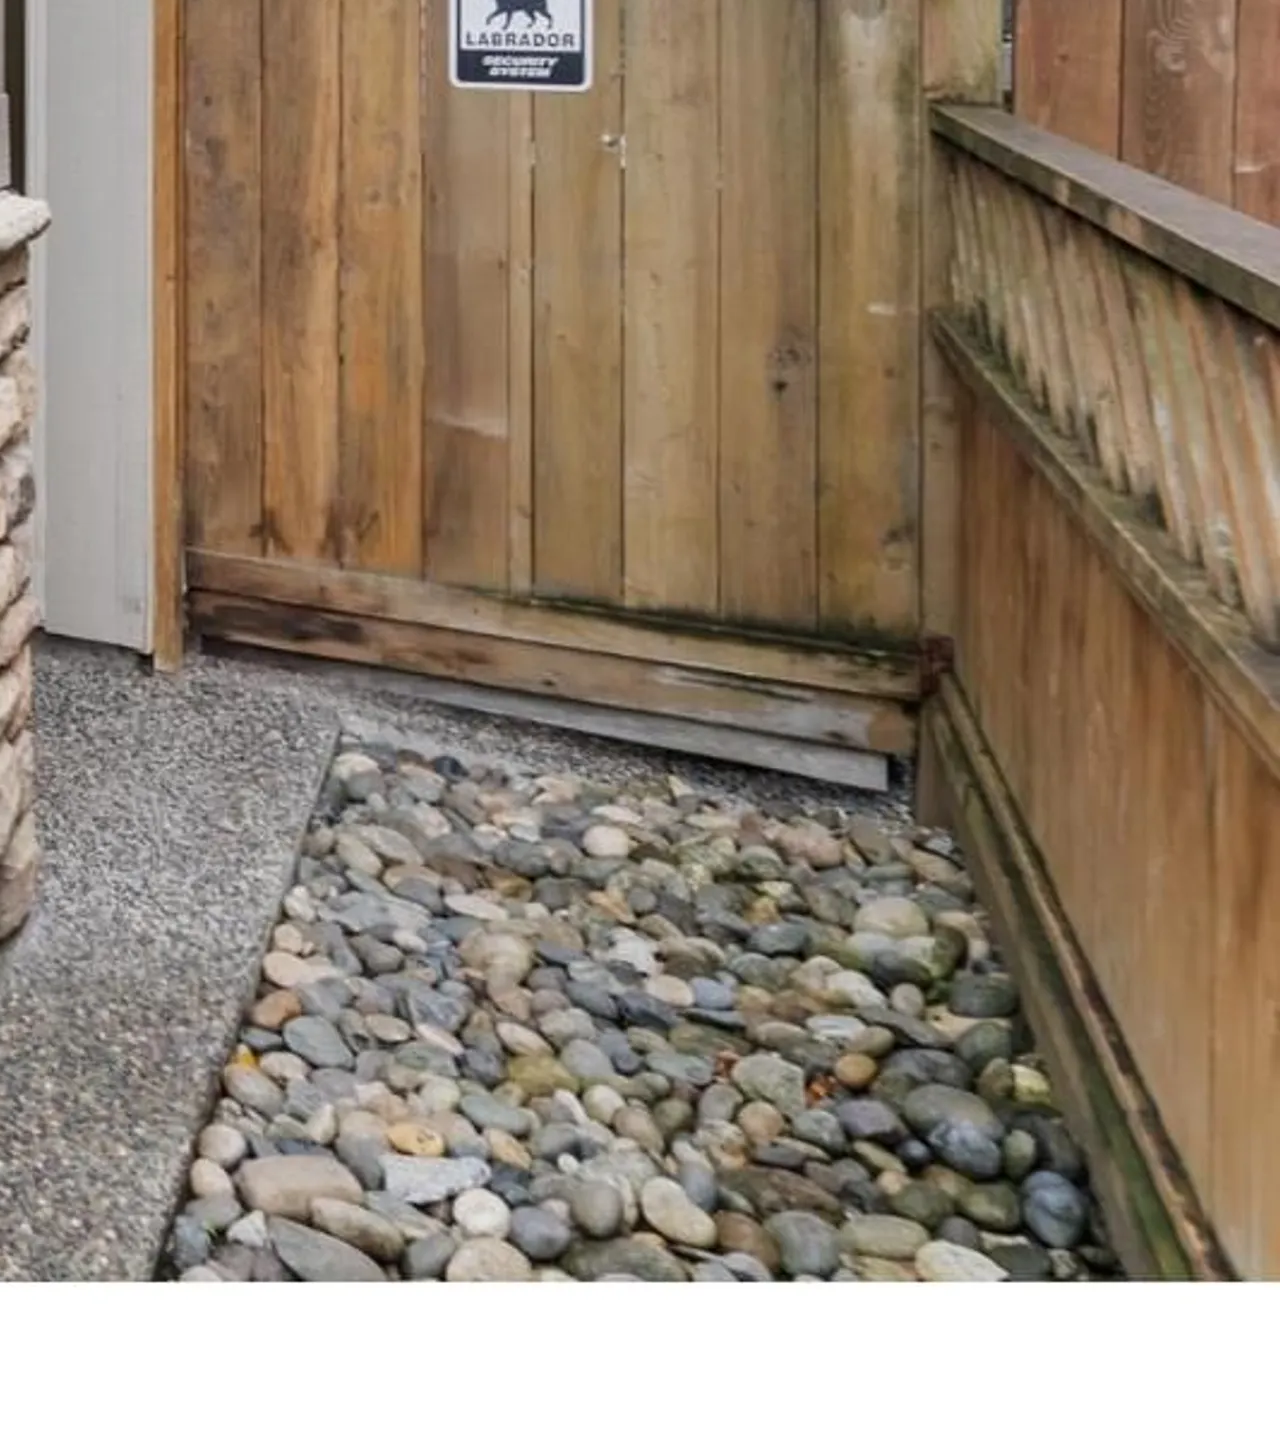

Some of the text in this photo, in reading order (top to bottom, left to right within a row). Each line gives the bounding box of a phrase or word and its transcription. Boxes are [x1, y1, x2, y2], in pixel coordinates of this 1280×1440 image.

[466, 31, 574, 47] LABRADOR
[481, 55, 559, 67] SECURITY
[488, 66, 551, 78] SYSTEM
